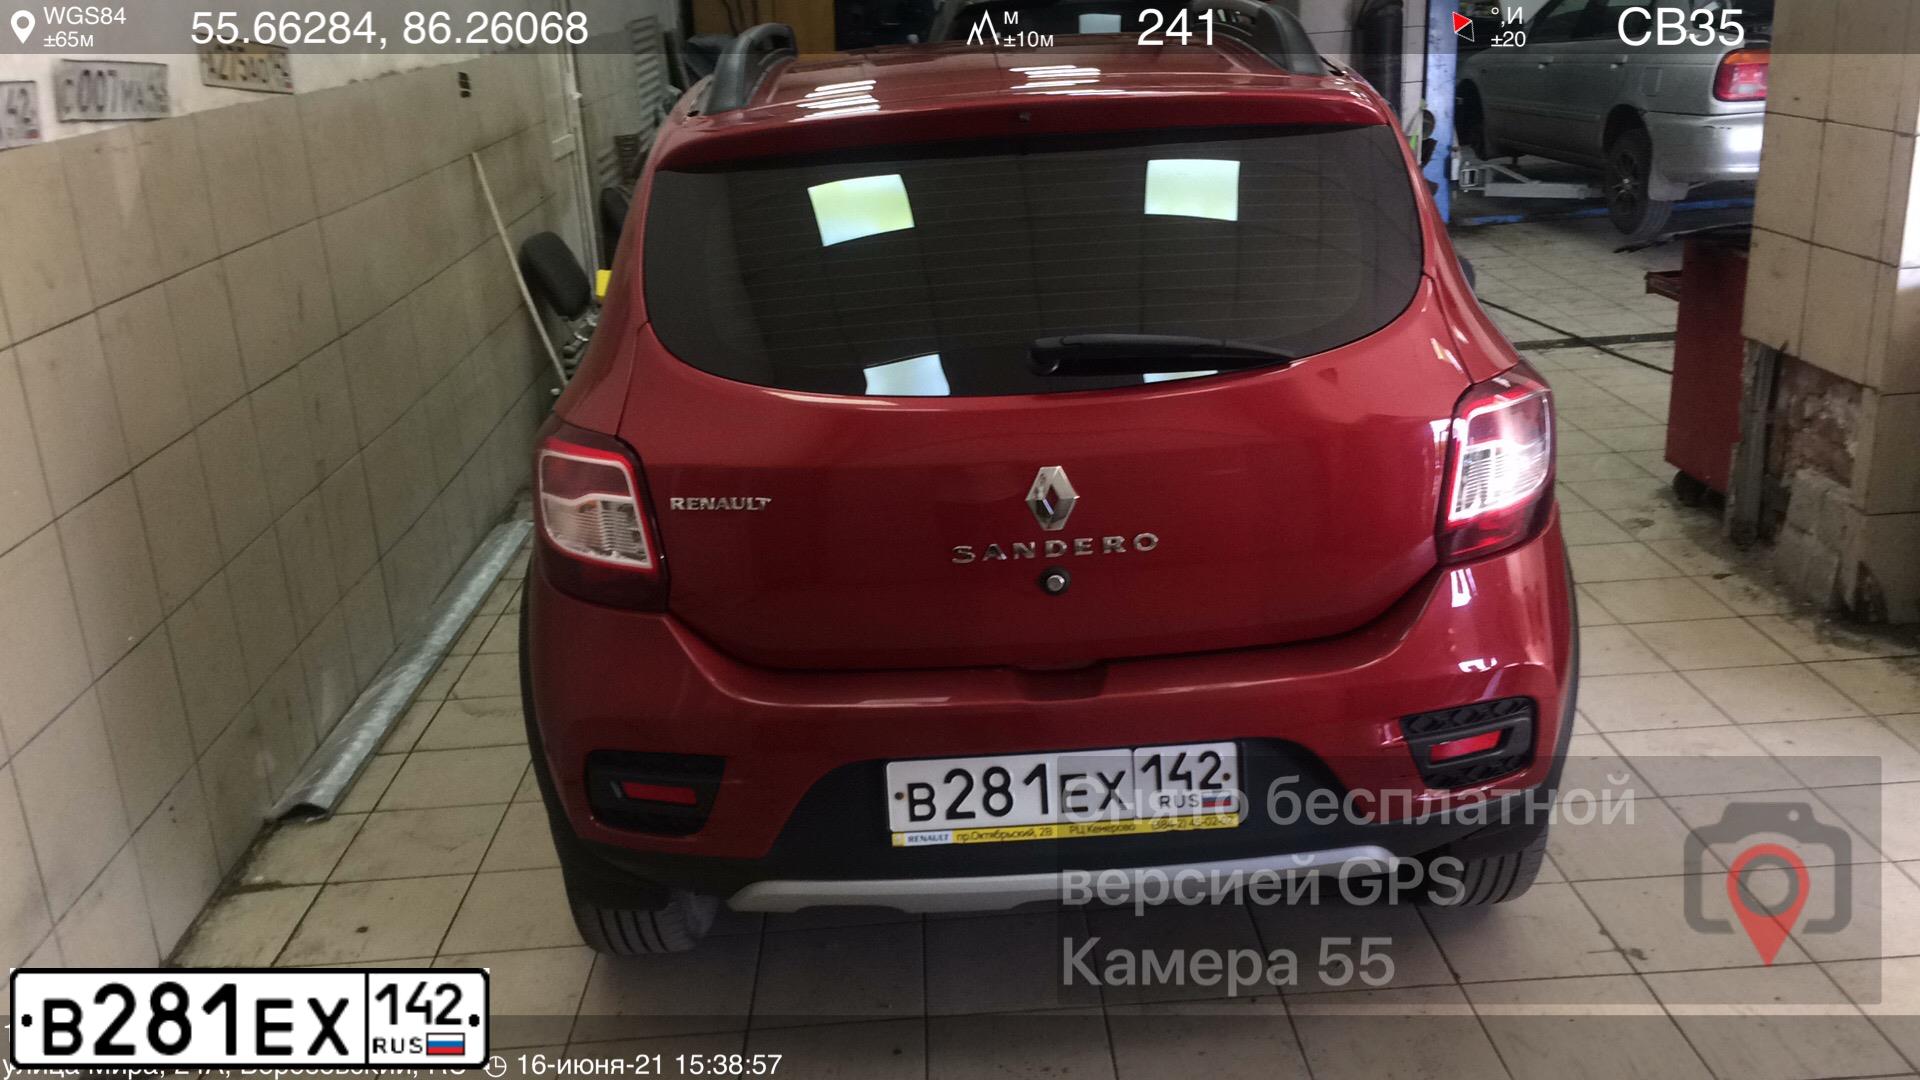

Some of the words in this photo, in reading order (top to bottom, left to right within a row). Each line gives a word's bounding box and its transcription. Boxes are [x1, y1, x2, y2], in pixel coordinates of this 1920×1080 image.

[670, 496, 772, 512] RENAULT
[951, 531, 1160, 565] SANDERO
[1140, 750, 1224, 792] 142
[1159, 792, 1200, 810] RUS
[907, 834, 950, 844] RENAULT
